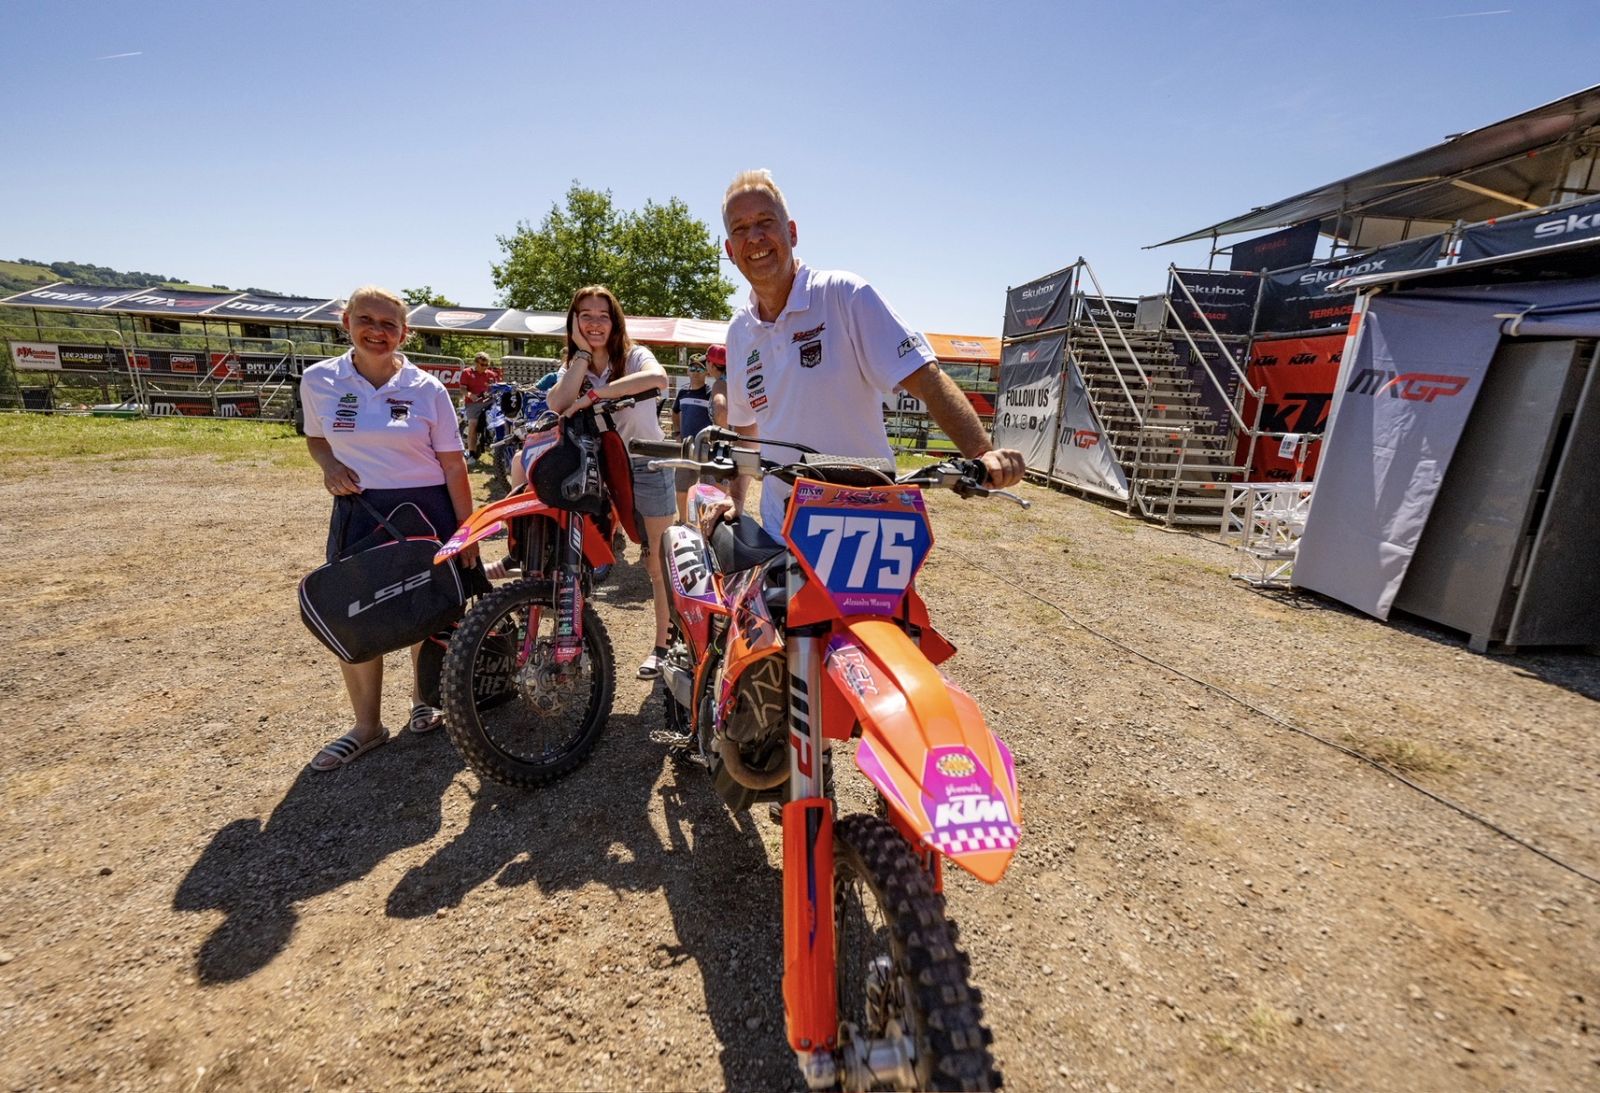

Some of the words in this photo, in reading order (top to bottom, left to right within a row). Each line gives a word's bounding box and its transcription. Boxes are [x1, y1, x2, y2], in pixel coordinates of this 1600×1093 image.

[1287, 353, 1318, 366] KTM
[1005, 389, 1036, 407] FOLLOW
[1037, 388, 1050, 408] US
[807, 514, 916, 590] 775
[935, 794, 1009, 828] KTM
